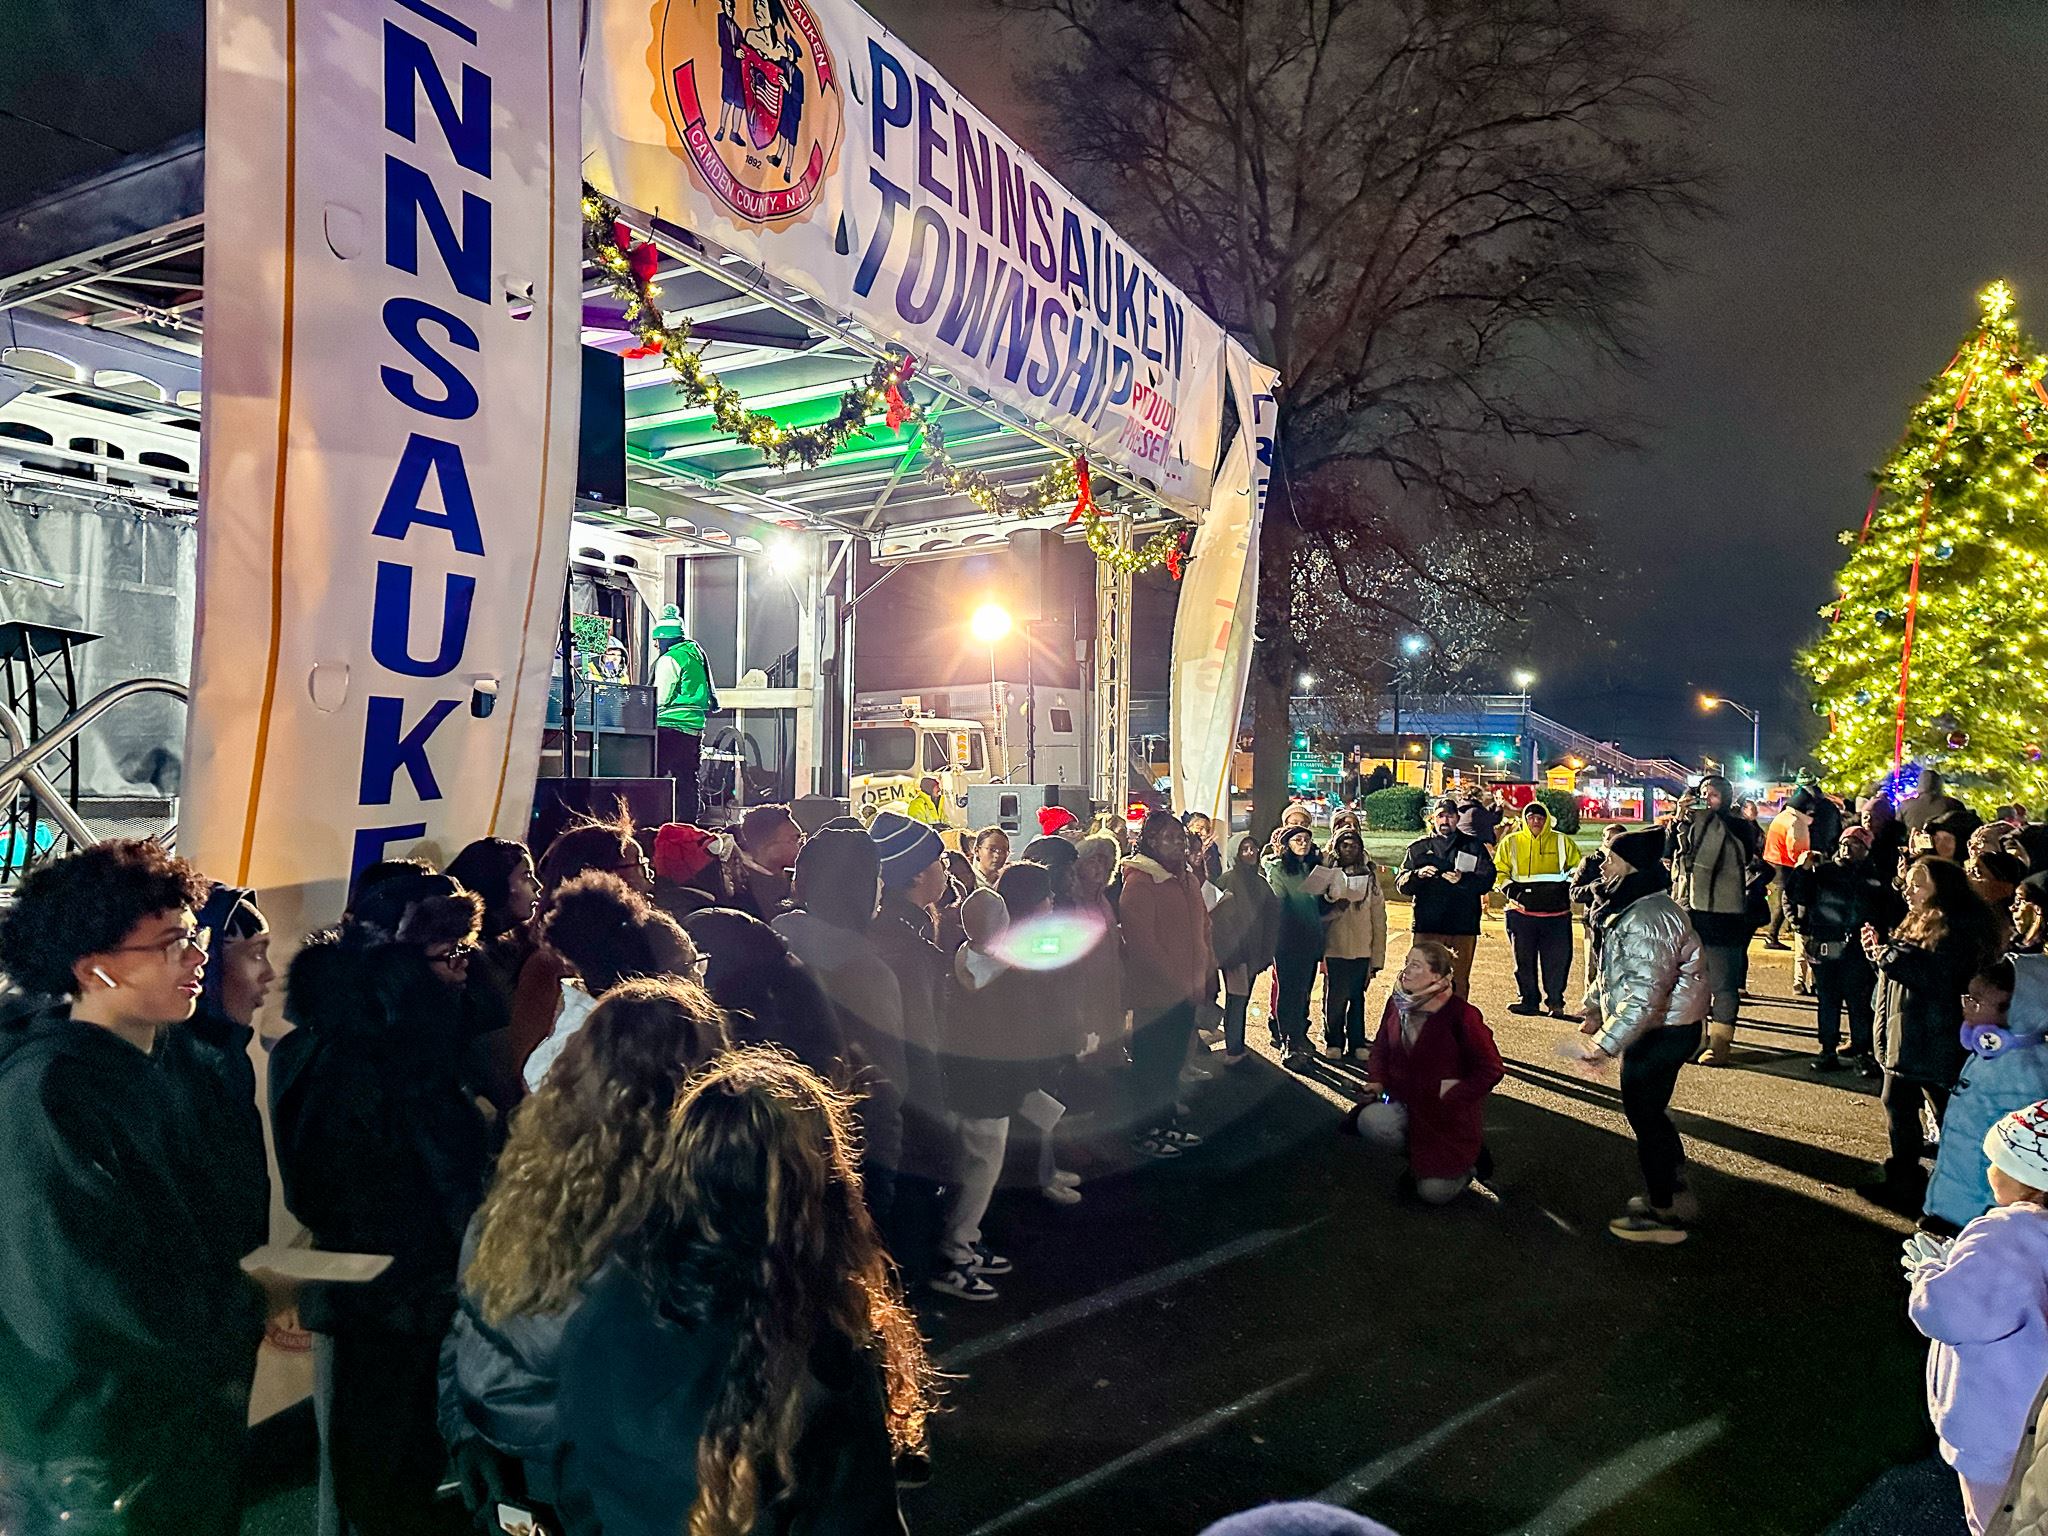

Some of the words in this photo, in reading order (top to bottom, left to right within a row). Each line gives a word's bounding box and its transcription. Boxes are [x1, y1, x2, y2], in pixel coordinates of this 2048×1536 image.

[691, 130, 735, 197] CAMDEN
[745, 155, 762, 169] 1892
[868, 37, 1183, 381] PENNSAUKEN
[852, 166, 1135, 430] TOWNSHIP
[862, 784, 905, 805] OEM
